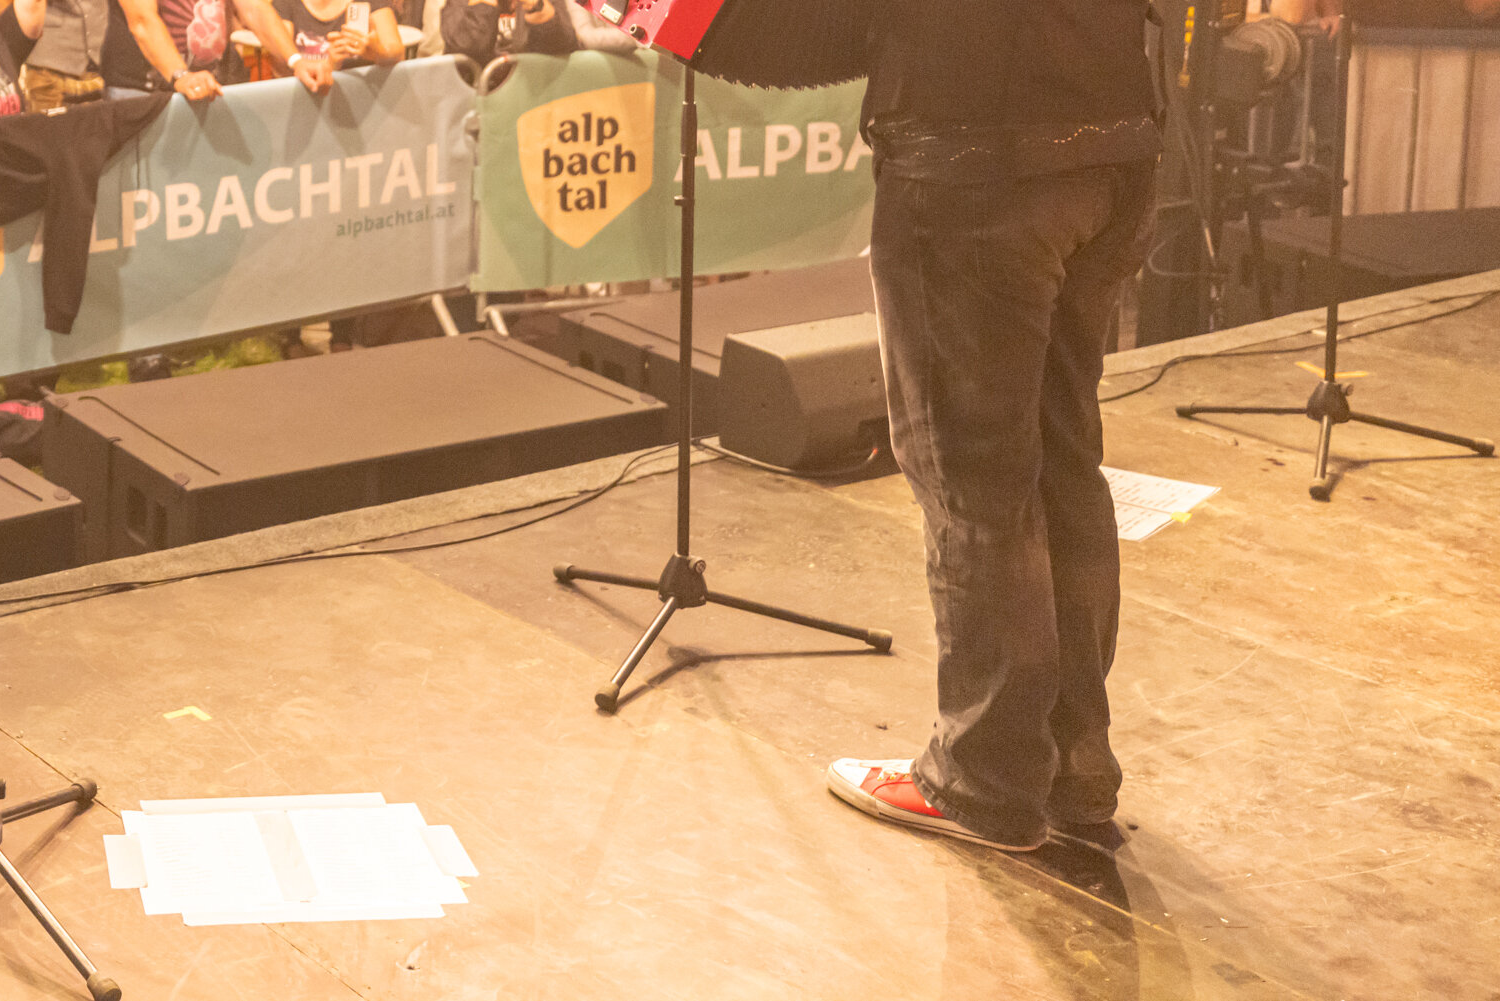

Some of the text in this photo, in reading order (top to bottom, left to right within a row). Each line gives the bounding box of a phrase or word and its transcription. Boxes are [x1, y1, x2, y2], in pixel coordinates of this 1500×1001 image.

[558, 111, 619, 147] alp
[543, 143, 636, 178] bach
[557, 179, 607, 213] tal
[336, 202, 456, 238] alpbachtal.at
